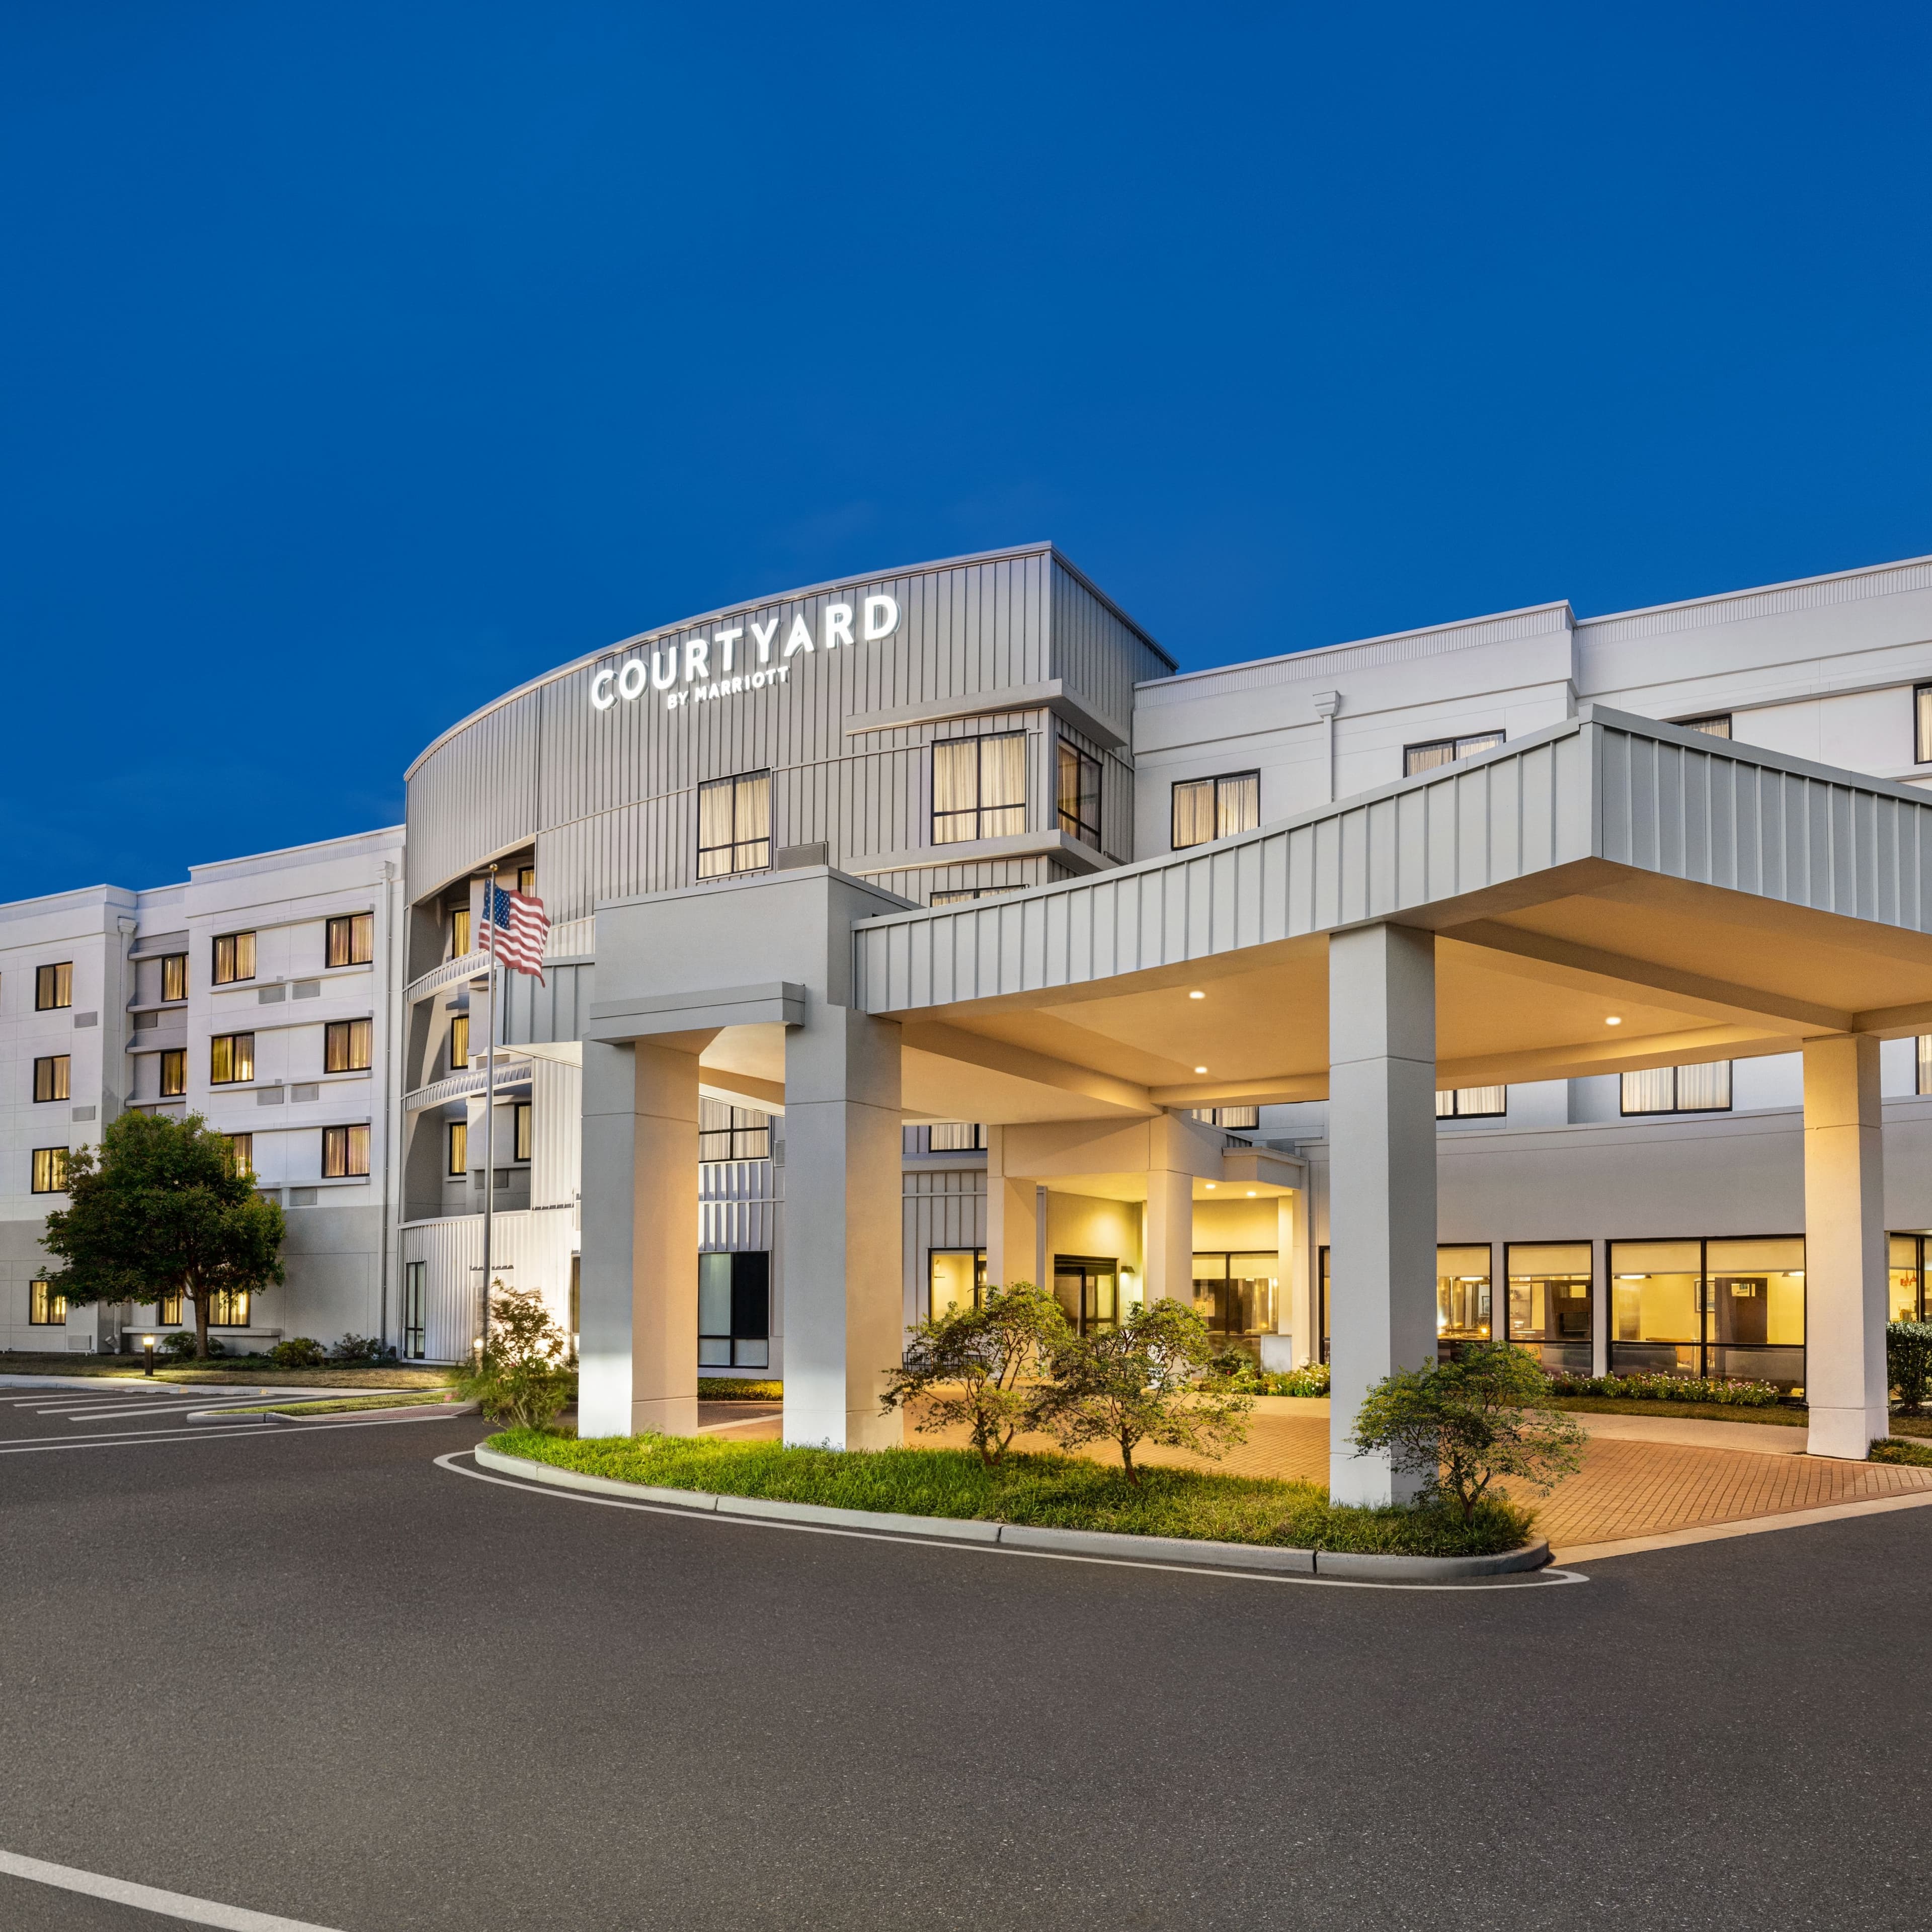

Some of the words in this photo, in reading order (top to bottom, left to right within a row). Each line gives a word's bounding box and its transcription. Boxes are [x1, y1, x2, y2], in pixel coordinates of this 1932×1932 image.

[592, 595, 900, 710] COURTYARD
[668, 691, 689, 709] BY
[695, 666, 789, 703] MARRIOTT
